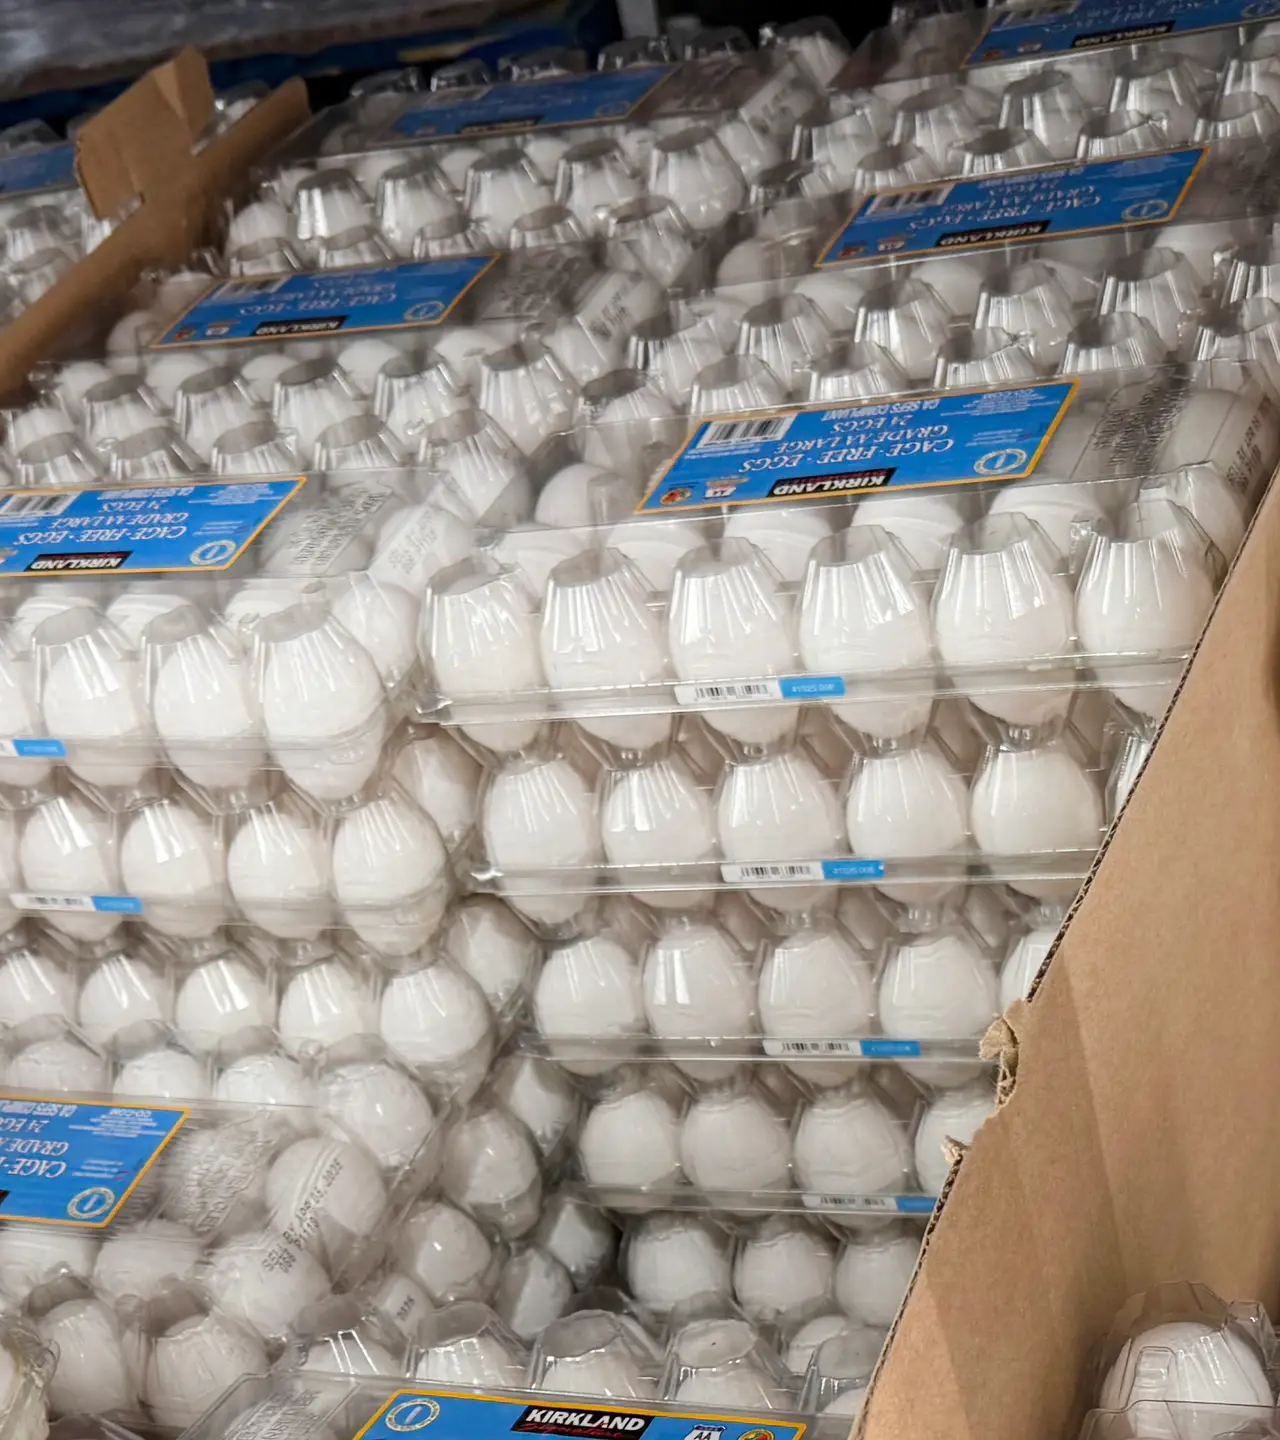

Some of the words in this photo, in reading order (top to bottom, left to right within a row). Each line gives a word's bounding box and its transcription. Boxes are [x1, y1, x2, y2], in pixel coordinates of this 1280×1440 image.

[938, 225, 1042, 245] KIRKLAND
[833, 417, 887, 434] EGGS
[888, 414, 908, 426] 24
[842, 431, 870, 445] AA
[871, 425, 949, 444] GRADE
[773, 436, 840, 454] LARGE
[738, 454, 809, 472] EGGS
[772, 475, 885, 496] KIRKLAND
[99, 500, 149, 512] EGGS
[50, 517, 102, 528] LARGE
[126, 512, 189, 523] GRADE
[13, 530, 70, 545] EGGS
[31, 557, 121, 569] KIRKLAND
[10, 1137, 69, 1156] GRADE
[525, 1409, 645, 1430] KIRKLAND
[693, 1431, 712, 1440] AA
